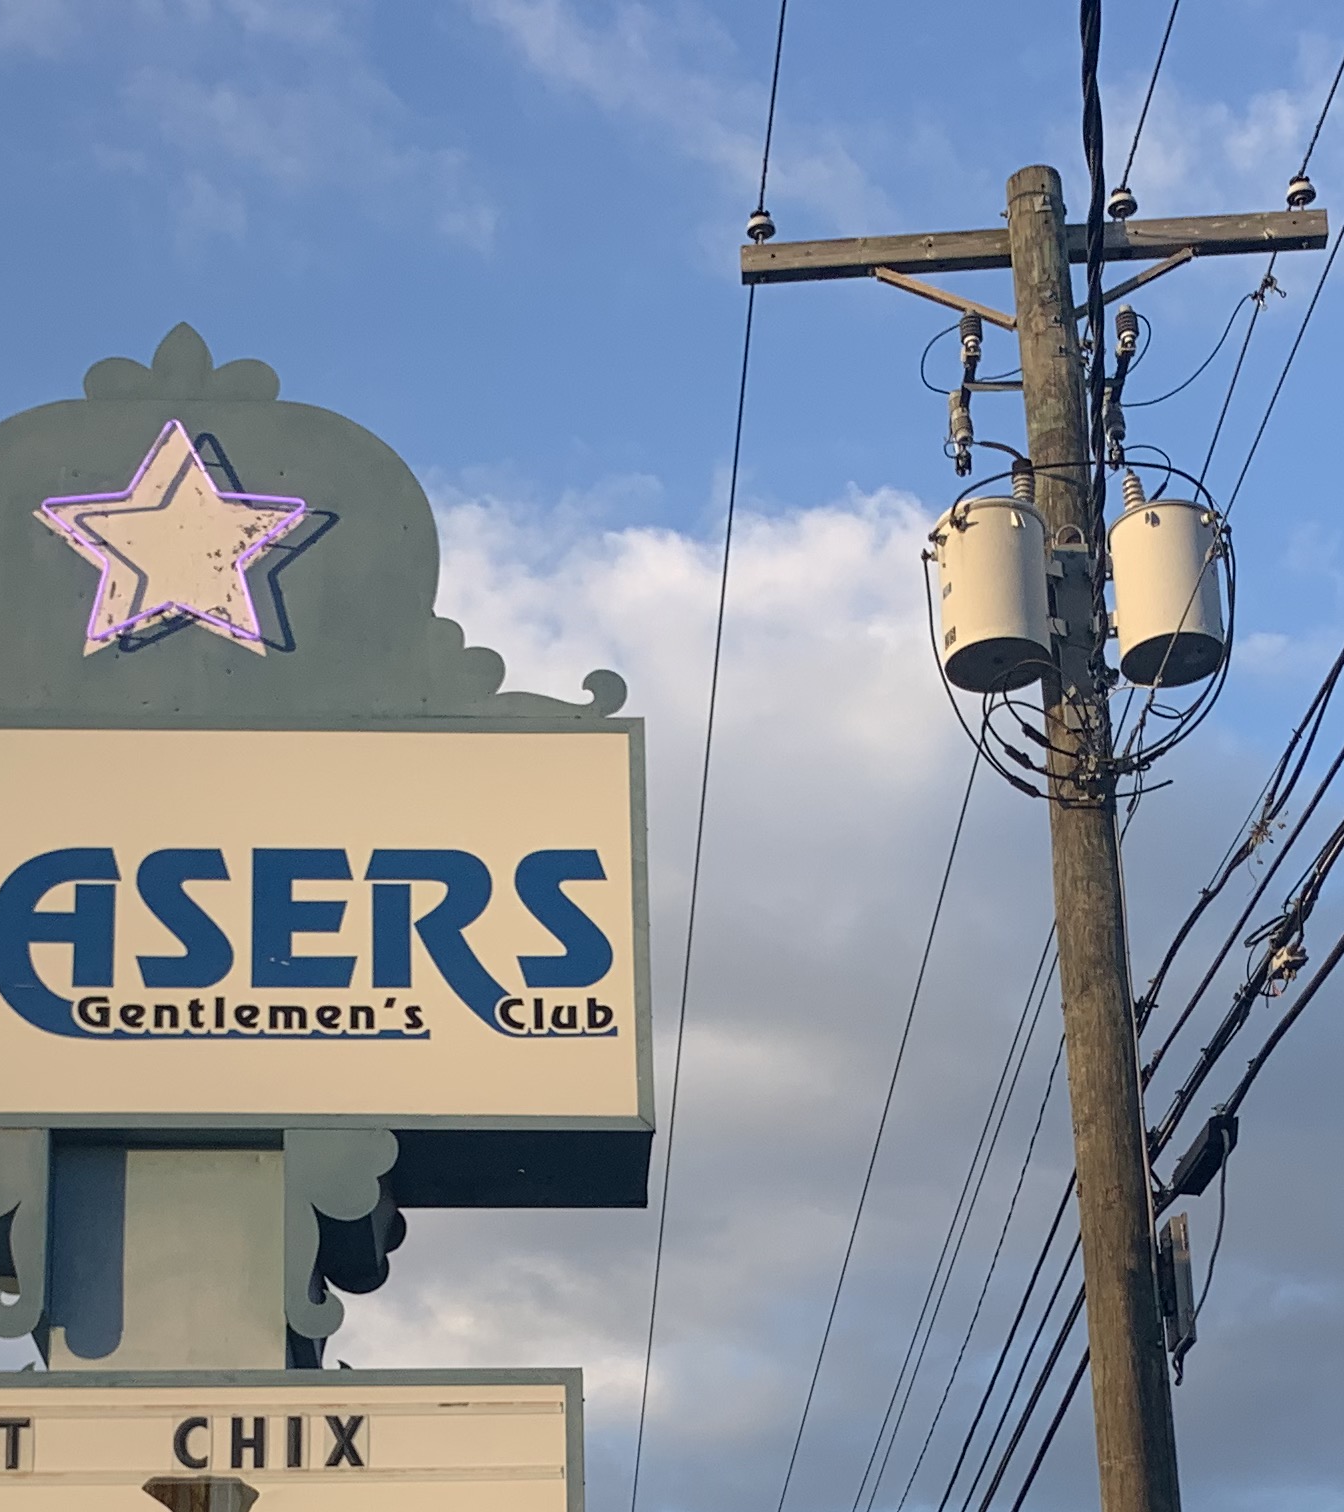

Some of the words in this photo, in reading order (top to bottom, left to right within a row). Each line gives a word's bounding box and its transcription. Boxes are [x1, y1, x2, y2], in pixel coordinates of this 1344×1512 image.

[76, 996, 424, 1031] Gentlemen's
[498, 997, 615, 1029] Club
[173, 1415, 365, 1469] CHIX
